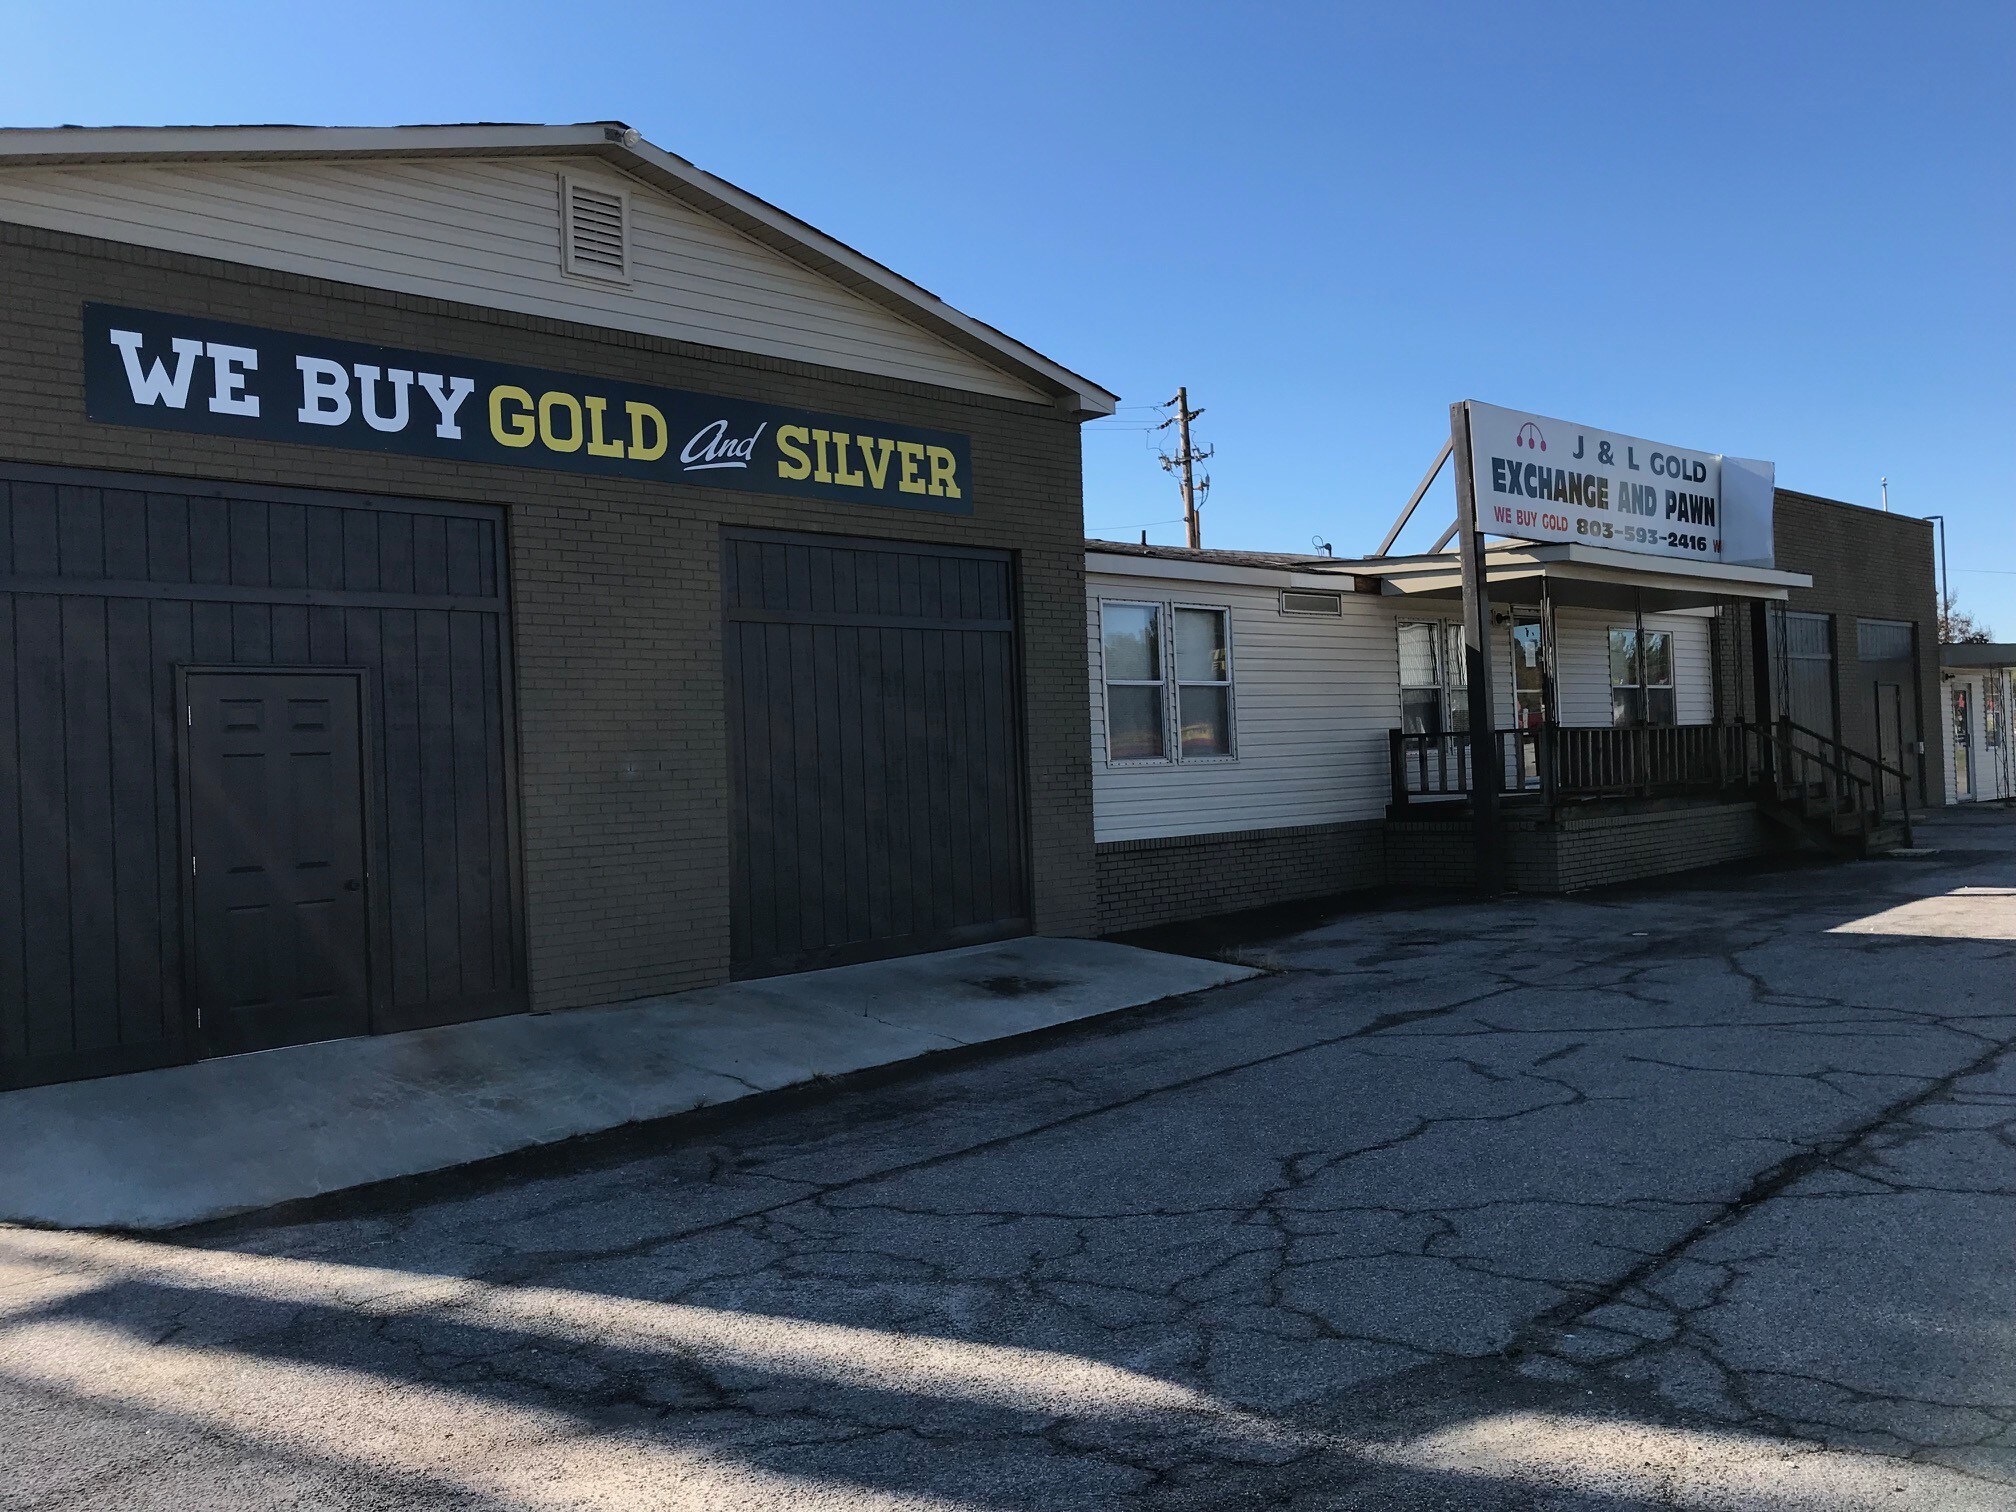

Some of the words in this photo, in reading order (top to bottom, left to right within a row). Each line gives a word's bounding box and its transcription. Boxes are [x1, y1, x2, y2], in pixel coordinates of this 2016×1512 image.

[109, 328, 260, 418] WE
[295, 354, 475, 440] BUY
[488, 384, 668, 462] GOLD
[679, 419, 767, 464] And
[775, 424, 962, 499] SILVER
[1572, 435, 1584, 460] J
[1597, 440, 1615, 467] &
[1627, 446, 1640, 471] L
[1650, 452, 1707, 483] GOLD
[1491, 457, 1609, 510] EXCHANGE
[1617, 481, 1657, 518] AND
[1665, 489, 1716, 527] PAWN
[1493, 505, 1512, 524] WE
[1516, 509, 1538, 528] BUY
[1542, 512, 1569, 532] GOLD
[1576, 518, 1707, 552] 803-593-2416
